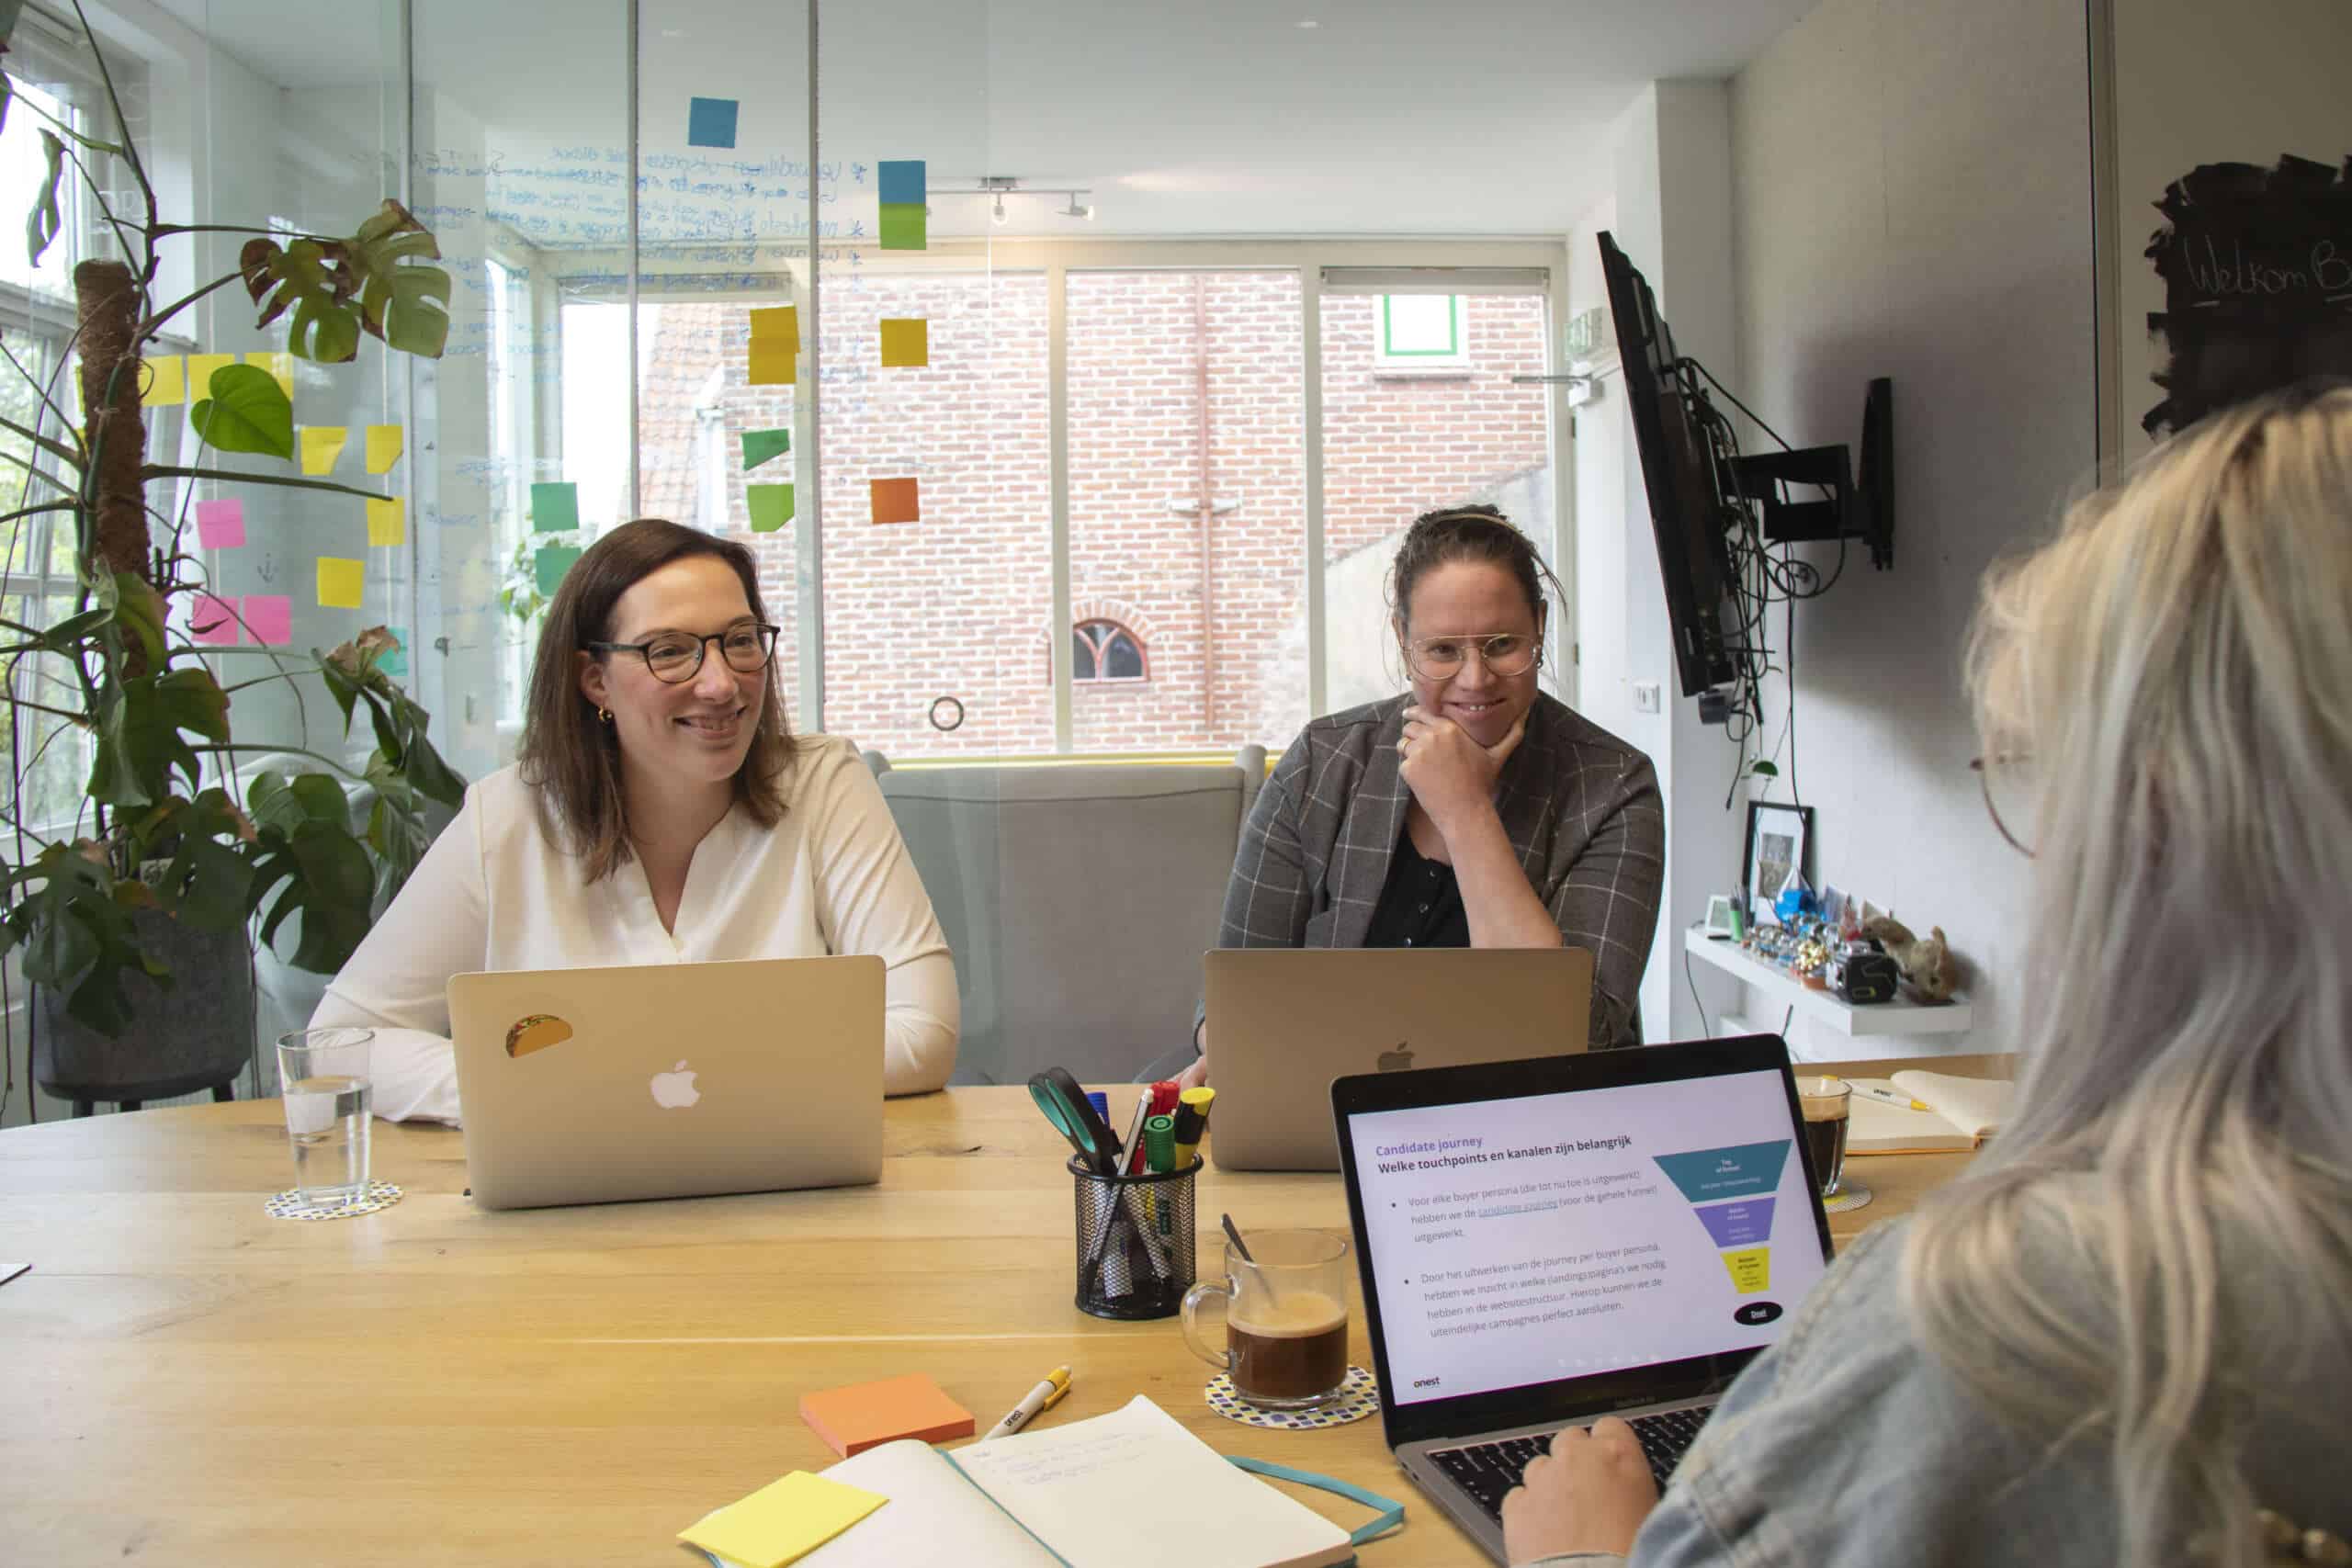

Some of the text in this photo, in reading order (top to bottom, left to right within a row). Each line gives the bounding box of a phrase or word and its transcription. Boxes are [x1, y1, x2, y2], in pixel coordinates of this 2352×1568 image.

[2183, 234, 2308, 295] Welkom
[1376, 1136, 1483, 1156] Candidate journey
[1378, 1134, 1633, 1174] Welke touchpoints en kanalen zijn belangrijk
[1408, 1196, 1430, 1207] Voor
[1432, 1193, 1452, 1205] elke
[1453, 1190, 1478, 1204] buyer
[1481, 1186, 1519, 1200] persona
[1538, 1179, 1552, 1191] tot
[1554, 1181, 1566, 1190] nu
[1566, 1178, 1581, 1189] toe
[1583, 1176, 1591, 1186] is
[1411, 1213, 1447, 1225] hebben
[1448, 1211, 1462, 1220] we
[1464, 1207, 1476, 1219] de
[1583, 1192, 1596, 1203] de
[1420, 1271, 1444, 1284] Door
[1446, 1269, 1463, 1280] het
[1511, 1261, 1528, 1270] van
[1530, 1257, 1542, 1269] de
[1544, 1255, 1577, 1271] journey
[1579, 1252, 1594, 1265] per
[1595, 1247, 1621, 1259] buyer
[1424, 1289, 1460, 1302] hebben
[1461, 1286, 1476, 1296] we
[1520, 1278, 1545, 1290] welke
[1626, 1264, 1640, 1272] we
[1641, 1258, 1667, 1272] nodig
[1427, 1306, 1464, 1320] hebben
[1476, 1303, 1488, 1314] de
[1637, 1280, 1650, 1289] we
[1651, 1278, 1663, 1287] de
[1543, 1307, 1574, 1324] perfect
[1413, 1376, 1441, 1388] onest
[1003, 1409, 1023, 1427] onest
